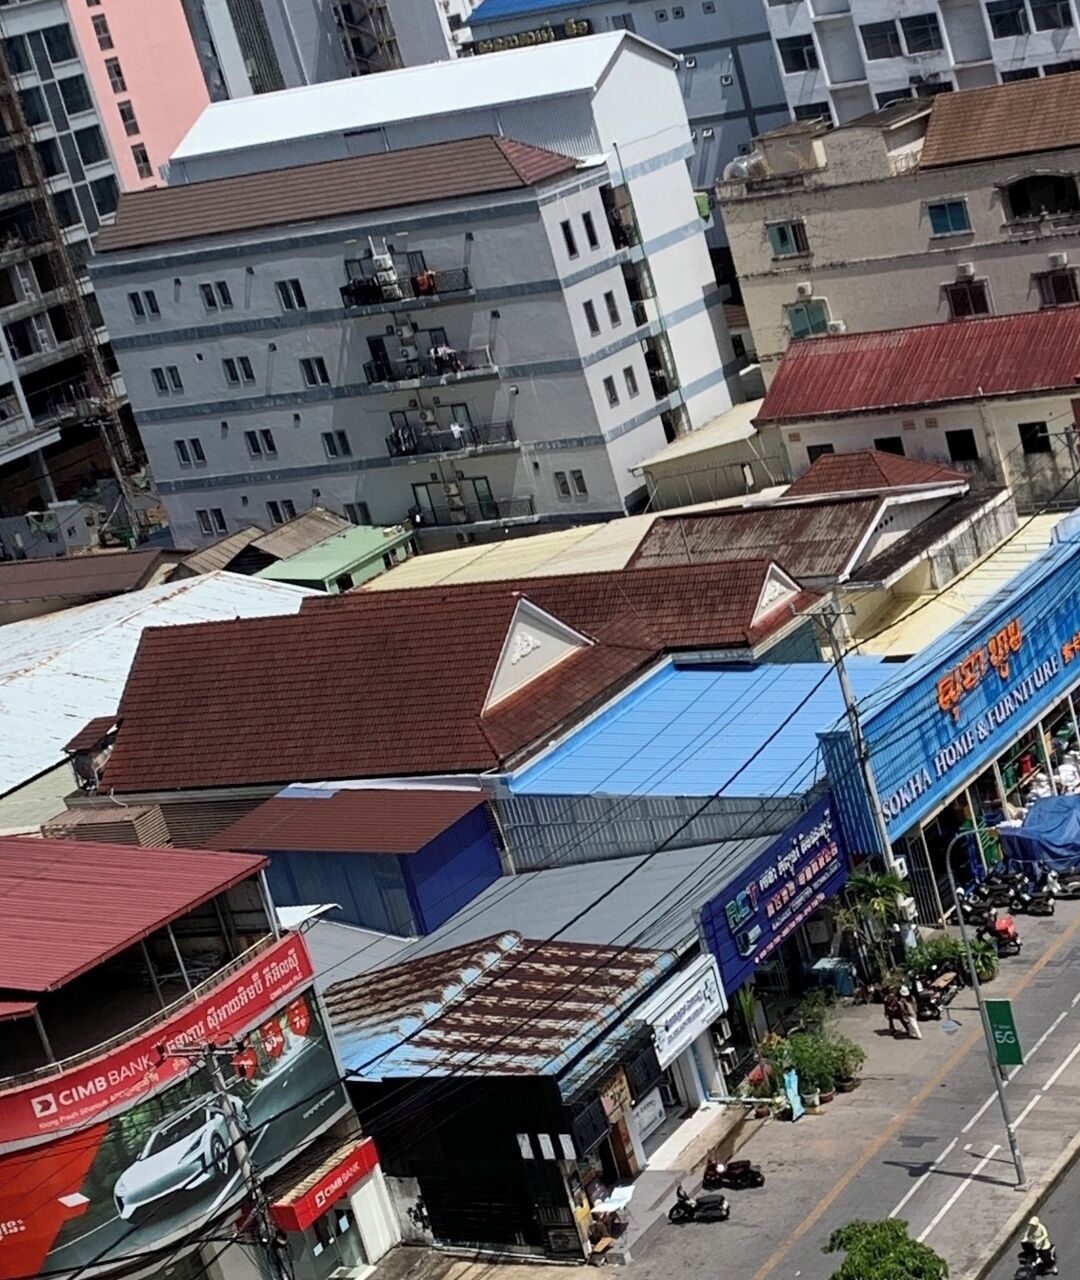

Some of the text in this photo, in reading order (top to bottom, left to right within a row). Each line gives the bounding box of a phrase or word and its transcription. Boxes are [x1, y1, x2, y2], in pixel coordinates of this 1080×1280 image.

[882, 767, 932, 822] SOKHA
[934, 730, 976, 777] HOME
[976, 723, 989, 741] &
[988, 654, 1060, 729] FURNITURE
[994, 1031, 1016, 1044] 5G
[58, 1076, 107, 1106] CIMB
[110, 1054, 155, 1087] BANK
[324, 1161, 361, 1198] CIMB BANK
